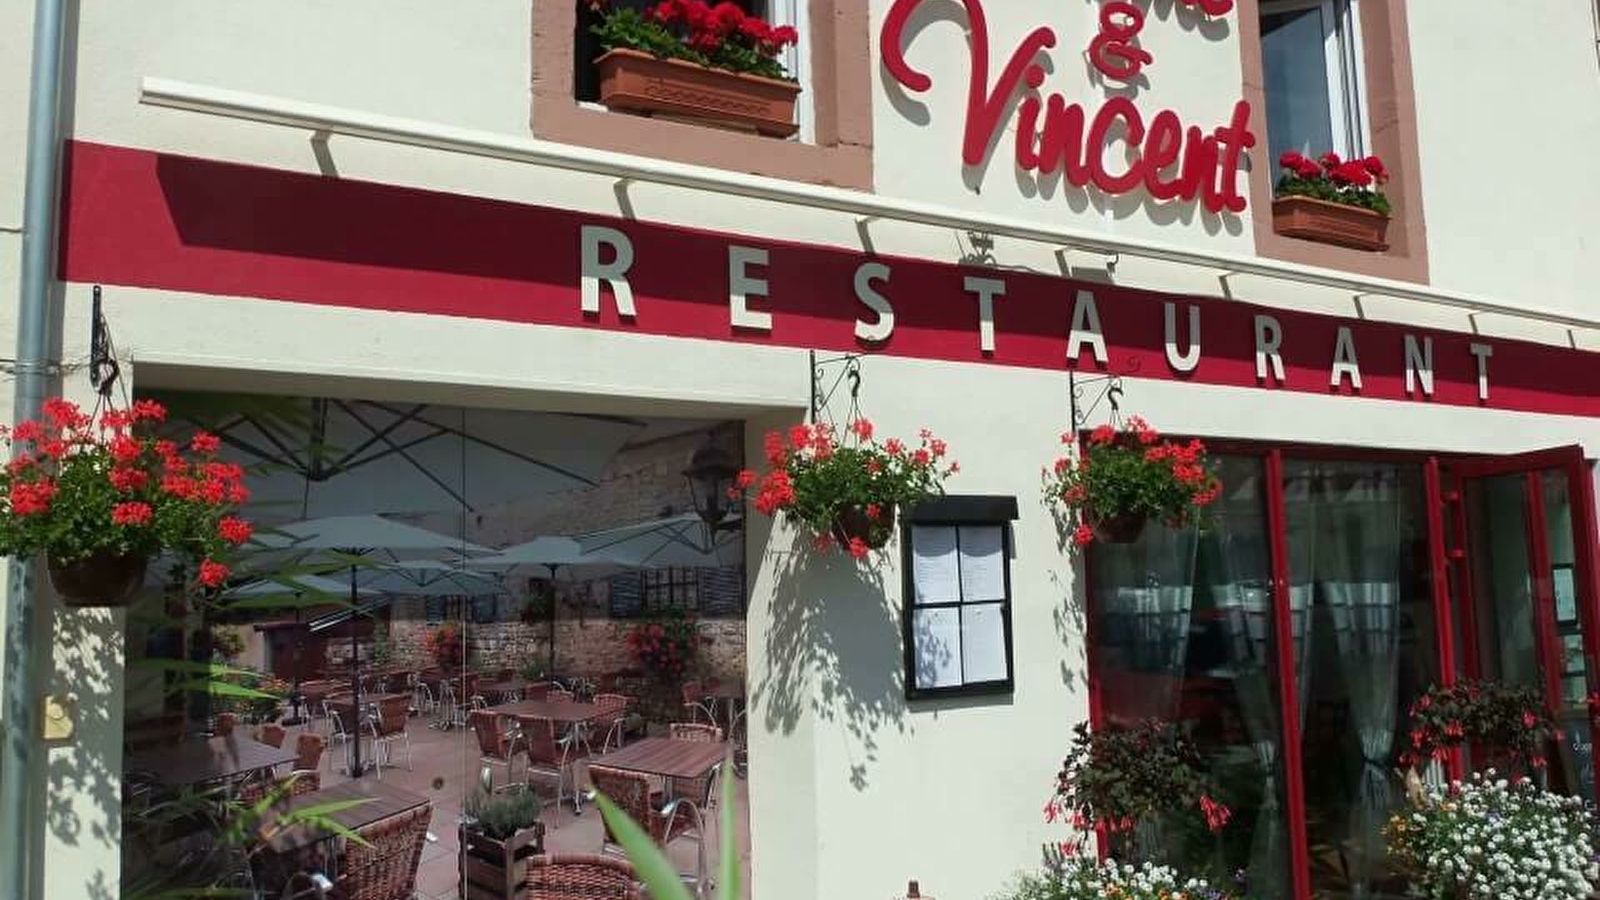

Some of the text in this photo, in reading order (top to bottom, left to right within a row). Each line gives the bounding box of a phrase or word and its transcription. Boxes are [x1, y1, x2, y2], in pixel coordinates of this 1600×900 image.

[880, 0, 1255, 213] Vincent
[1088, 2, 1153, 80] &
[580, 224, 1493, 400] RESTAURANT
